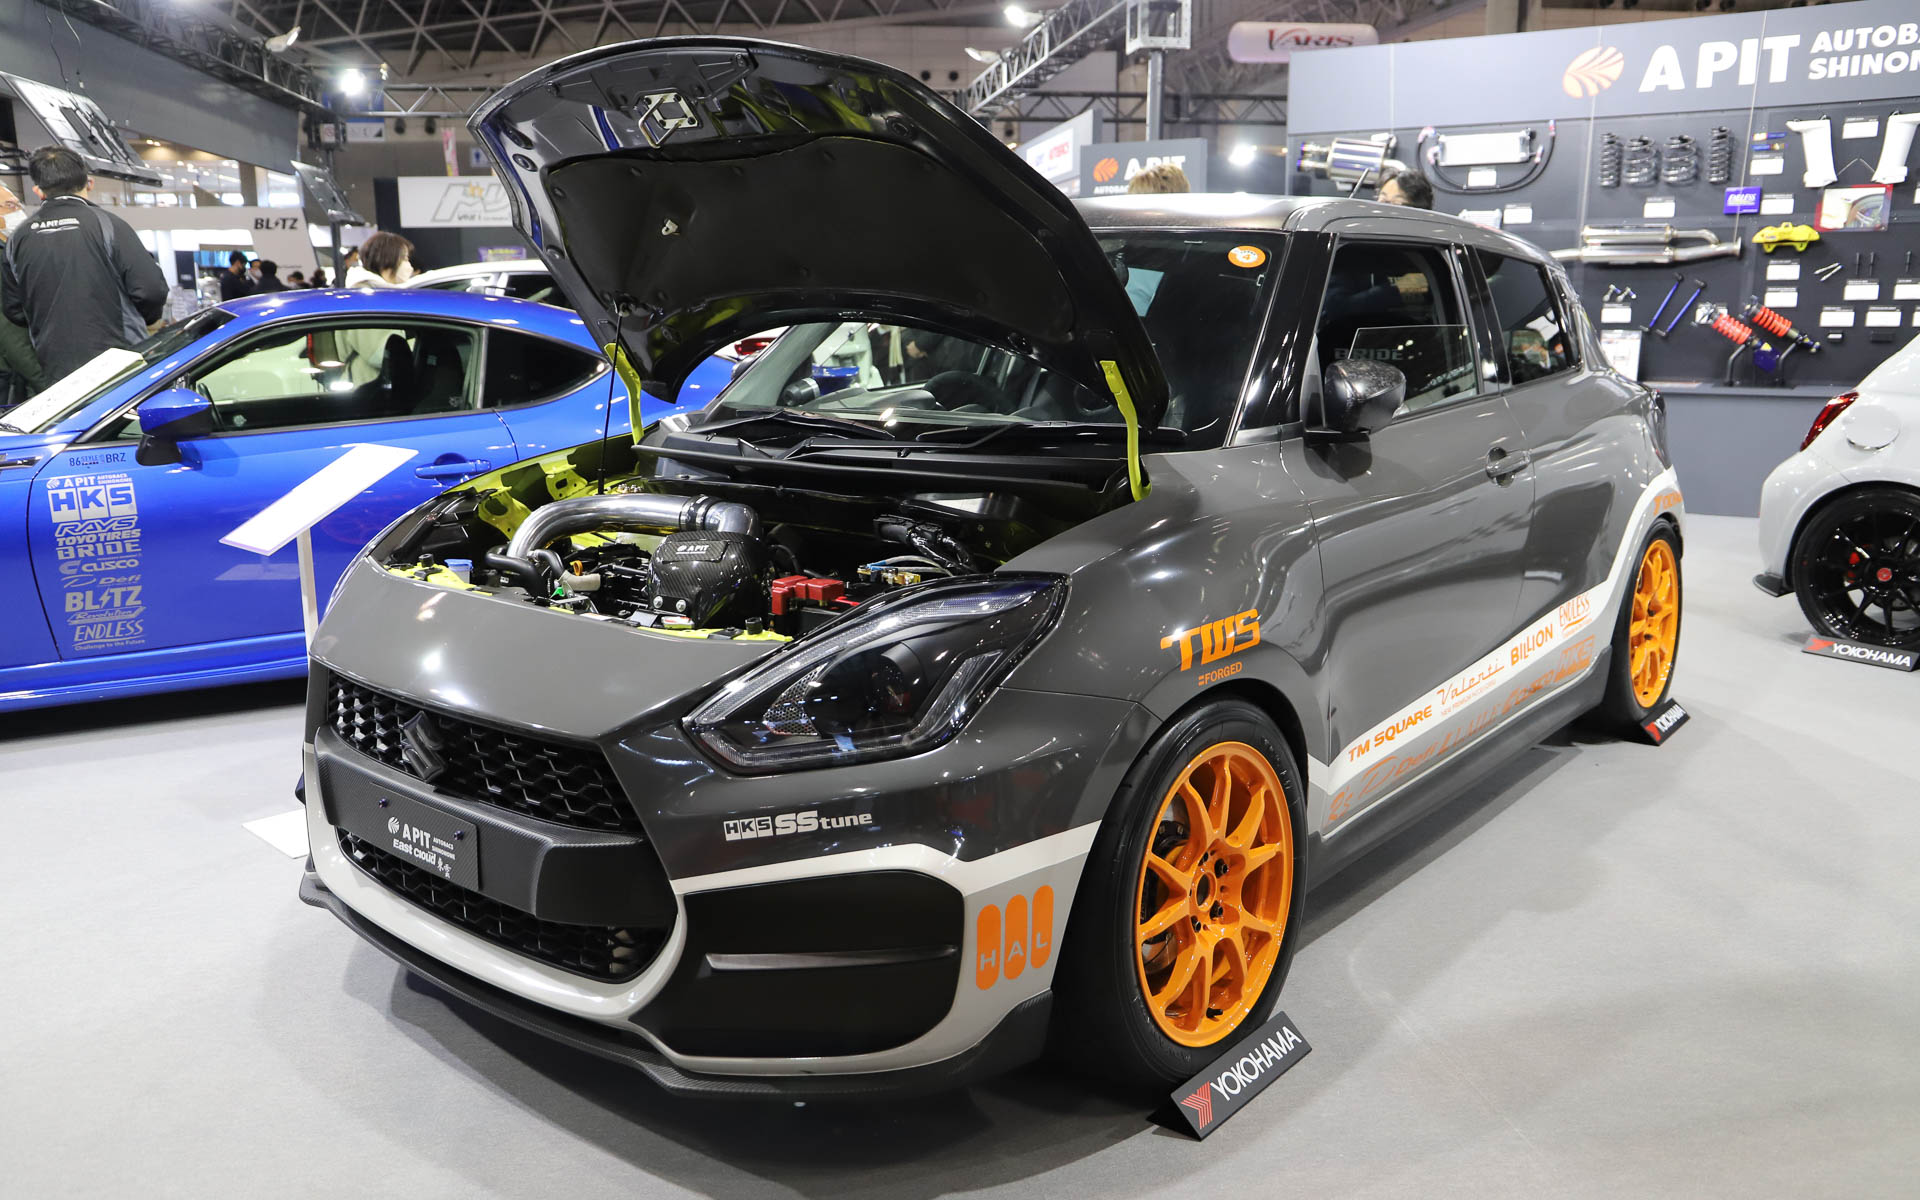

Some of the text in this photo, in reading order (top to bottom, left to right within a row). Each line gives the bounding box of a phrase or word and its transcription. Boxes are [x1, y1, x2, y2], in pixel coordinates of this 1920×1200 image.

[1810, 23, 1920, 54] AUTOB
[1334, 348, 1404, 360] BRIDE
[69, 457, 81, 467] 86
[105, 452, 126, 463] BRZ
[48, 482, 138, 523] HKS
[55, 516, 138, 537] RAYS
[56, 539, 142, 560] BRIDE
[73, 619, 144, 642] ENDLESS
[1160, 608, 1261, 672] TWS
[1832, 643, 1911, 667] YOKOHAMA
[1348, 739, 1370, 762] TM
[1374, 704, 1432, 748] SQUARE
[1510, 623, 1553, 667] BILLION
[723, 816, 773, 841] HKS
[392, 838, 437, 865] East Cloud
[980, 932, 1049, 971] HAL
[1210, 1026, 1303, 1101] YOKOHAMA
